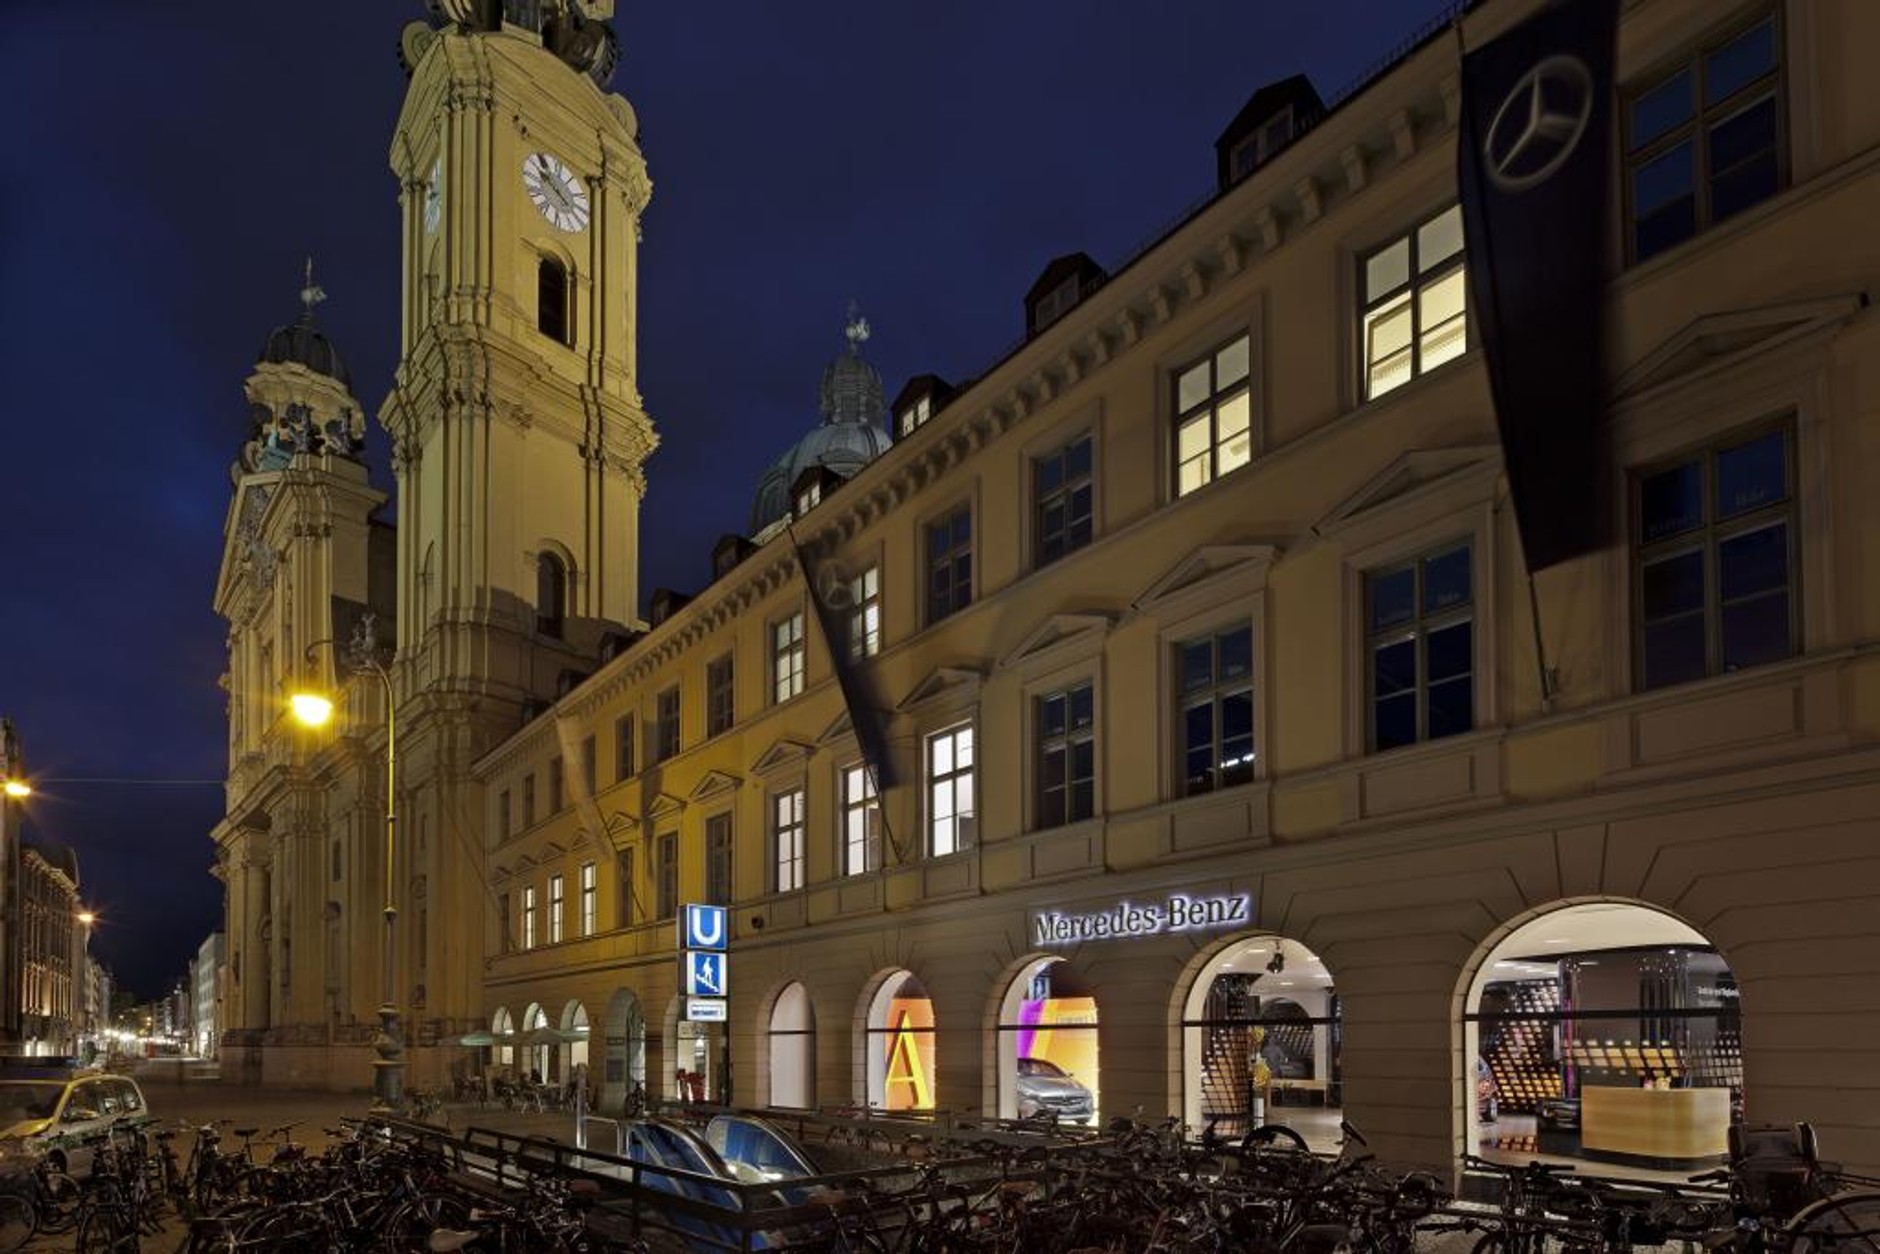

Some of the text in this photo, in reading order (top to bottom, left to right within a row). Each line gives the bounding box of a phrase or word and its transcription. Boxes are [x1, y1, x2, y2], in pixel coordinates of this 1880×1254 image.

[692, 907, 721, 945] U
[1035, 895, 1247, 943] Mercedes-Benz
[885, 1010, 934, 1109] A
